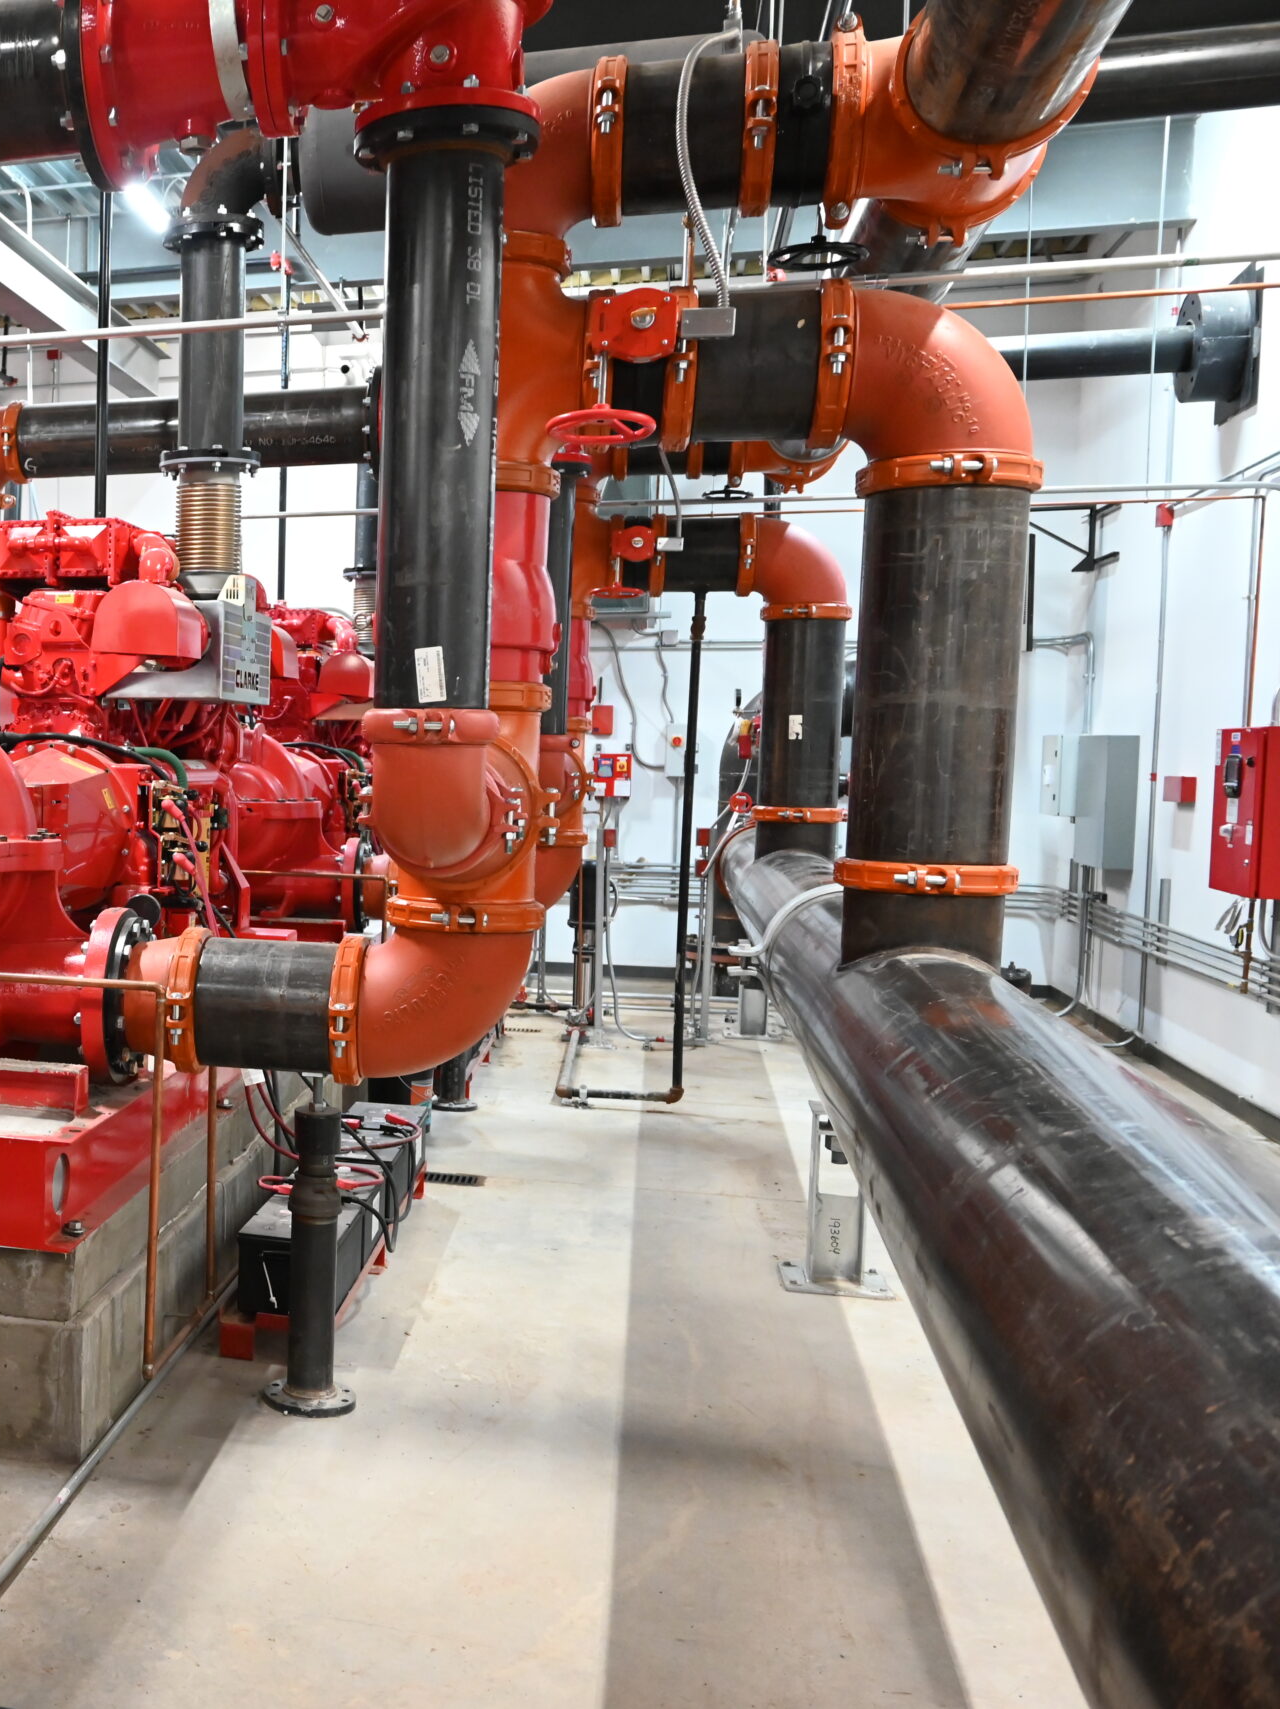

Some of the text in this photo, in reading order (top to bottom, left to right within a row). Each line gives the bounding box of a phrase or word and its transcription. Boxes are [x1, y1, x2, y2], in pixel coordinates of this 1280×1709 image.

[468, 163, 484, 235] LISTED
[467, 246, 482, 272] 38
[459, 372, 475, 412] FM
[235, 669, 259, 691] CLARKE
